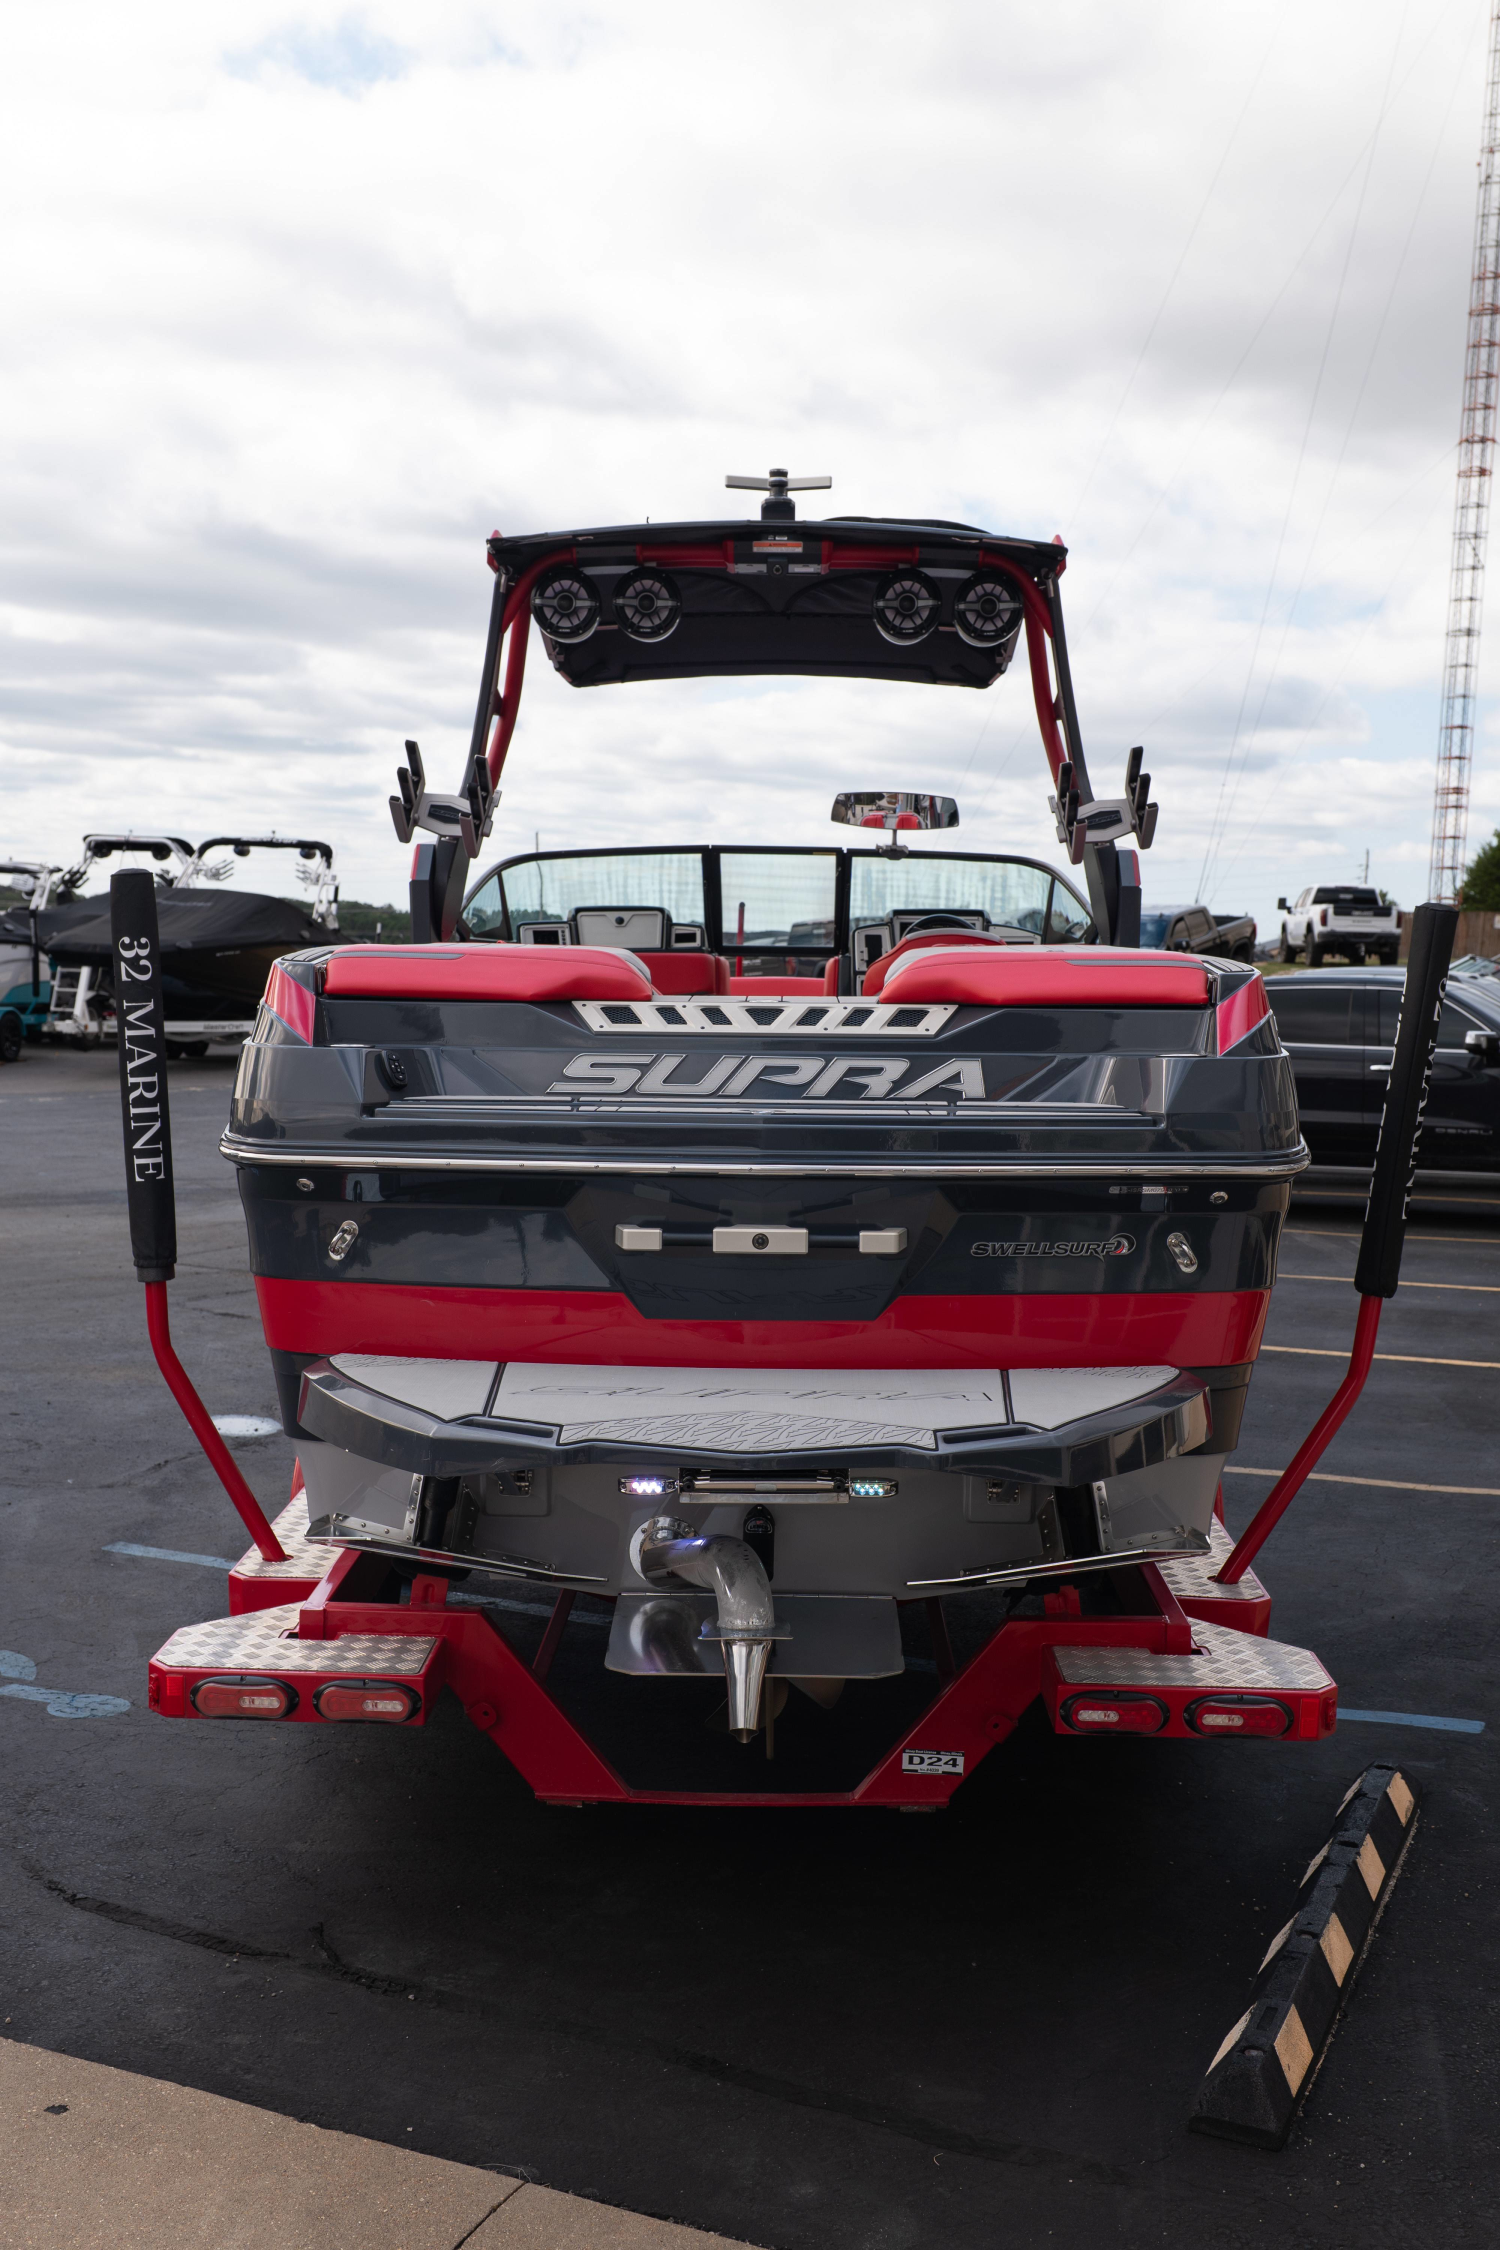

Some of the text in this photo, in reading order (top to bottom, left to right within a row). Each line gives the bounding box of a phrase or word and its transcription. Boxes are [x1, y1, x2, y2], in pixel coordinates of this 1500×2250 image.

[118, 936, 166, 1183] 32 MARINE
[545, 1052, 987, 1100] SUPRA
[1435, 1127, 1493, 1135] DENALI
[970, 1241, 1118, 1262] SWELLSURF
[908, 1755, 960, 1768] D24
